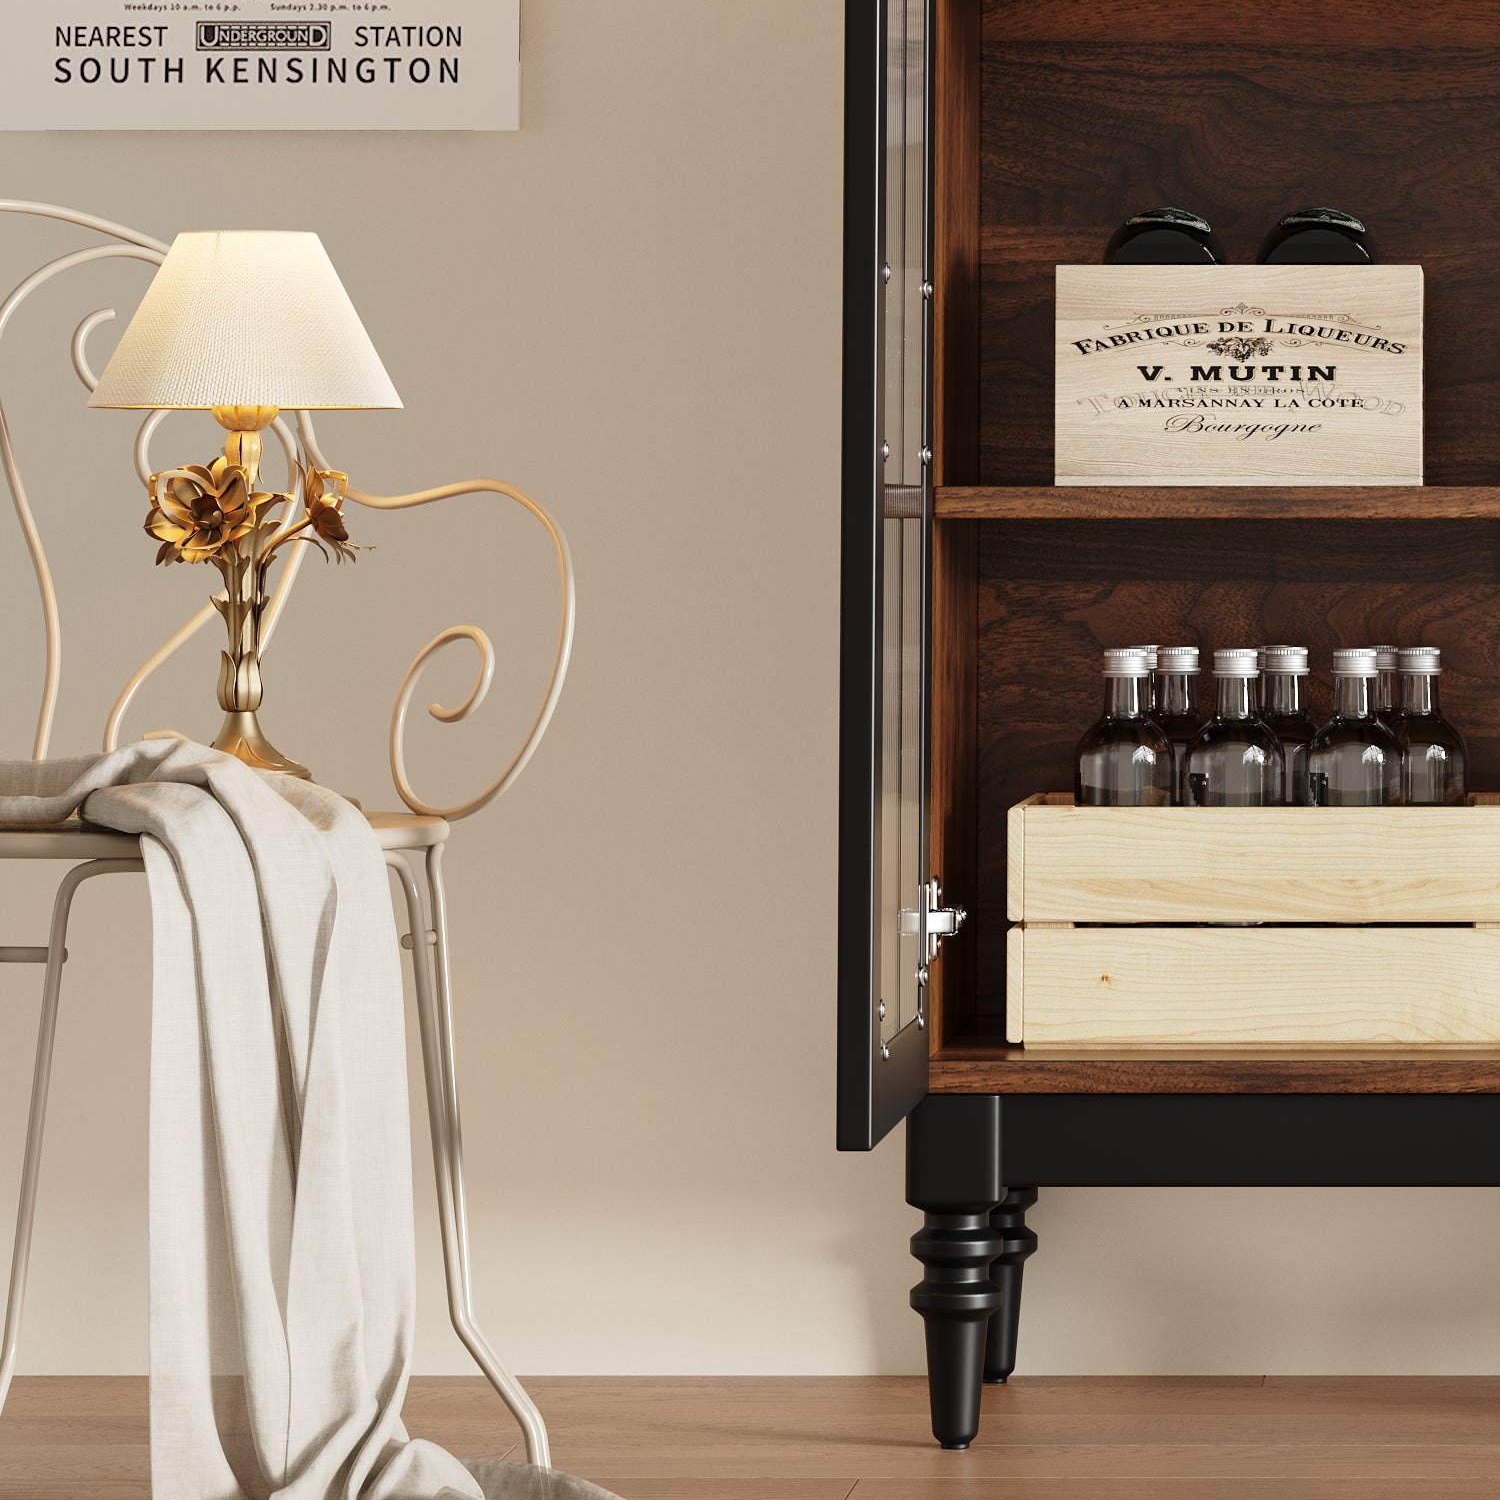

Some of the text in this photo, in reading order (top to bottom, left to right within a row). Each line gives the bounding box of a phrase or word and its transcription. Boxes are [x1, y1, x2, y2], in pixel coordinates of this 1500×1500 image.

[124, 3, 167, 13] Weekdays
[204, 3, 214, 11] to
[270, 3, 307, 13] Sundays
[352, 3, 362, 11] to
[56, 24, 462, 48] NEAREST UNDERGROUND STATION
[54, 57, 460, 84] SOUTH KENSINGTON
[1072, 318, 1408, 355] FABRIQUE DE LIQUEURS
[1137, 365, 1337, 382] V. MUTIN
[1138, 398, 1265, 408] MARSANNAY
[1274, 398, 1300, 408] LA
[1164, 414, 1323, 441] Bourgogne
